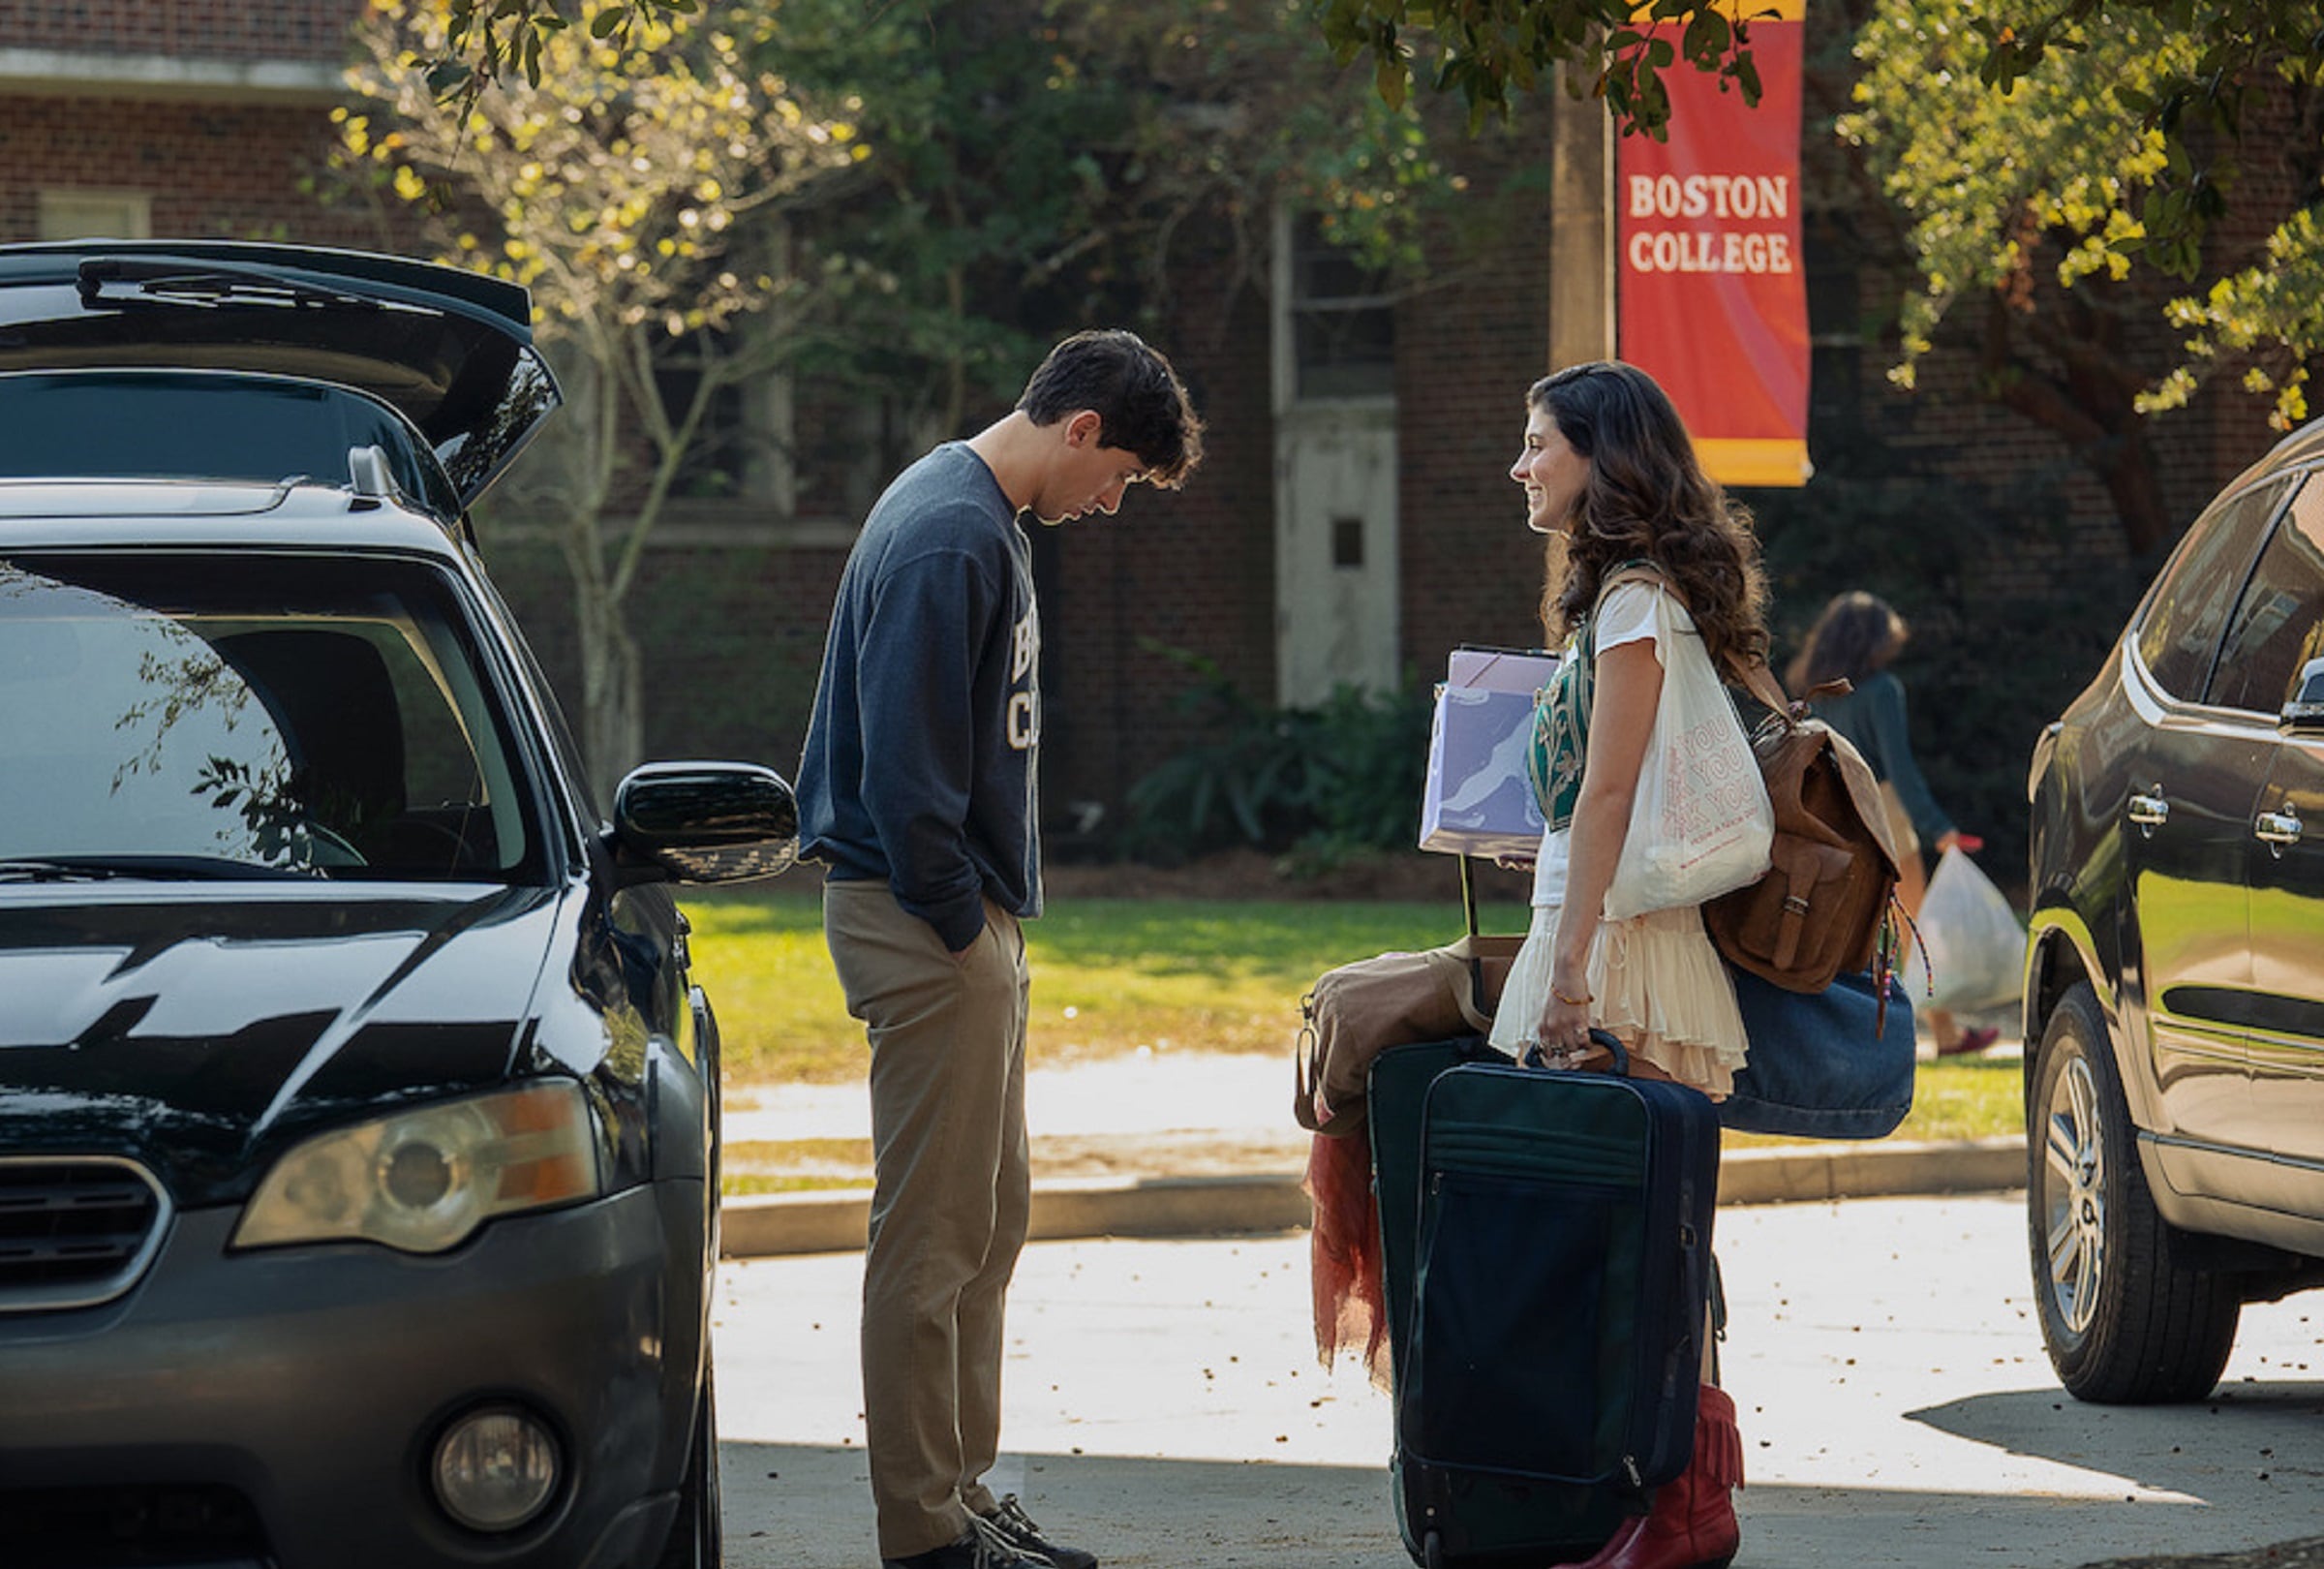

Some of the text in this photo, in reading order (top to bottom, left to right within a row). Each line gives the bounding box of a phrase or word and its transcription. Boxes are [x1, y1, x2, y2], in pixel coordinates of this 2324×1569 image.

[1629, 174, 1789, 219] BOSTON
[1629, 231, 1792, 273] COLLEGE
[1678, 714, 1730, 757] YOU
[1692, 744, 1744, 786] YOU
[1705, 774, 1756, 815] YOU
